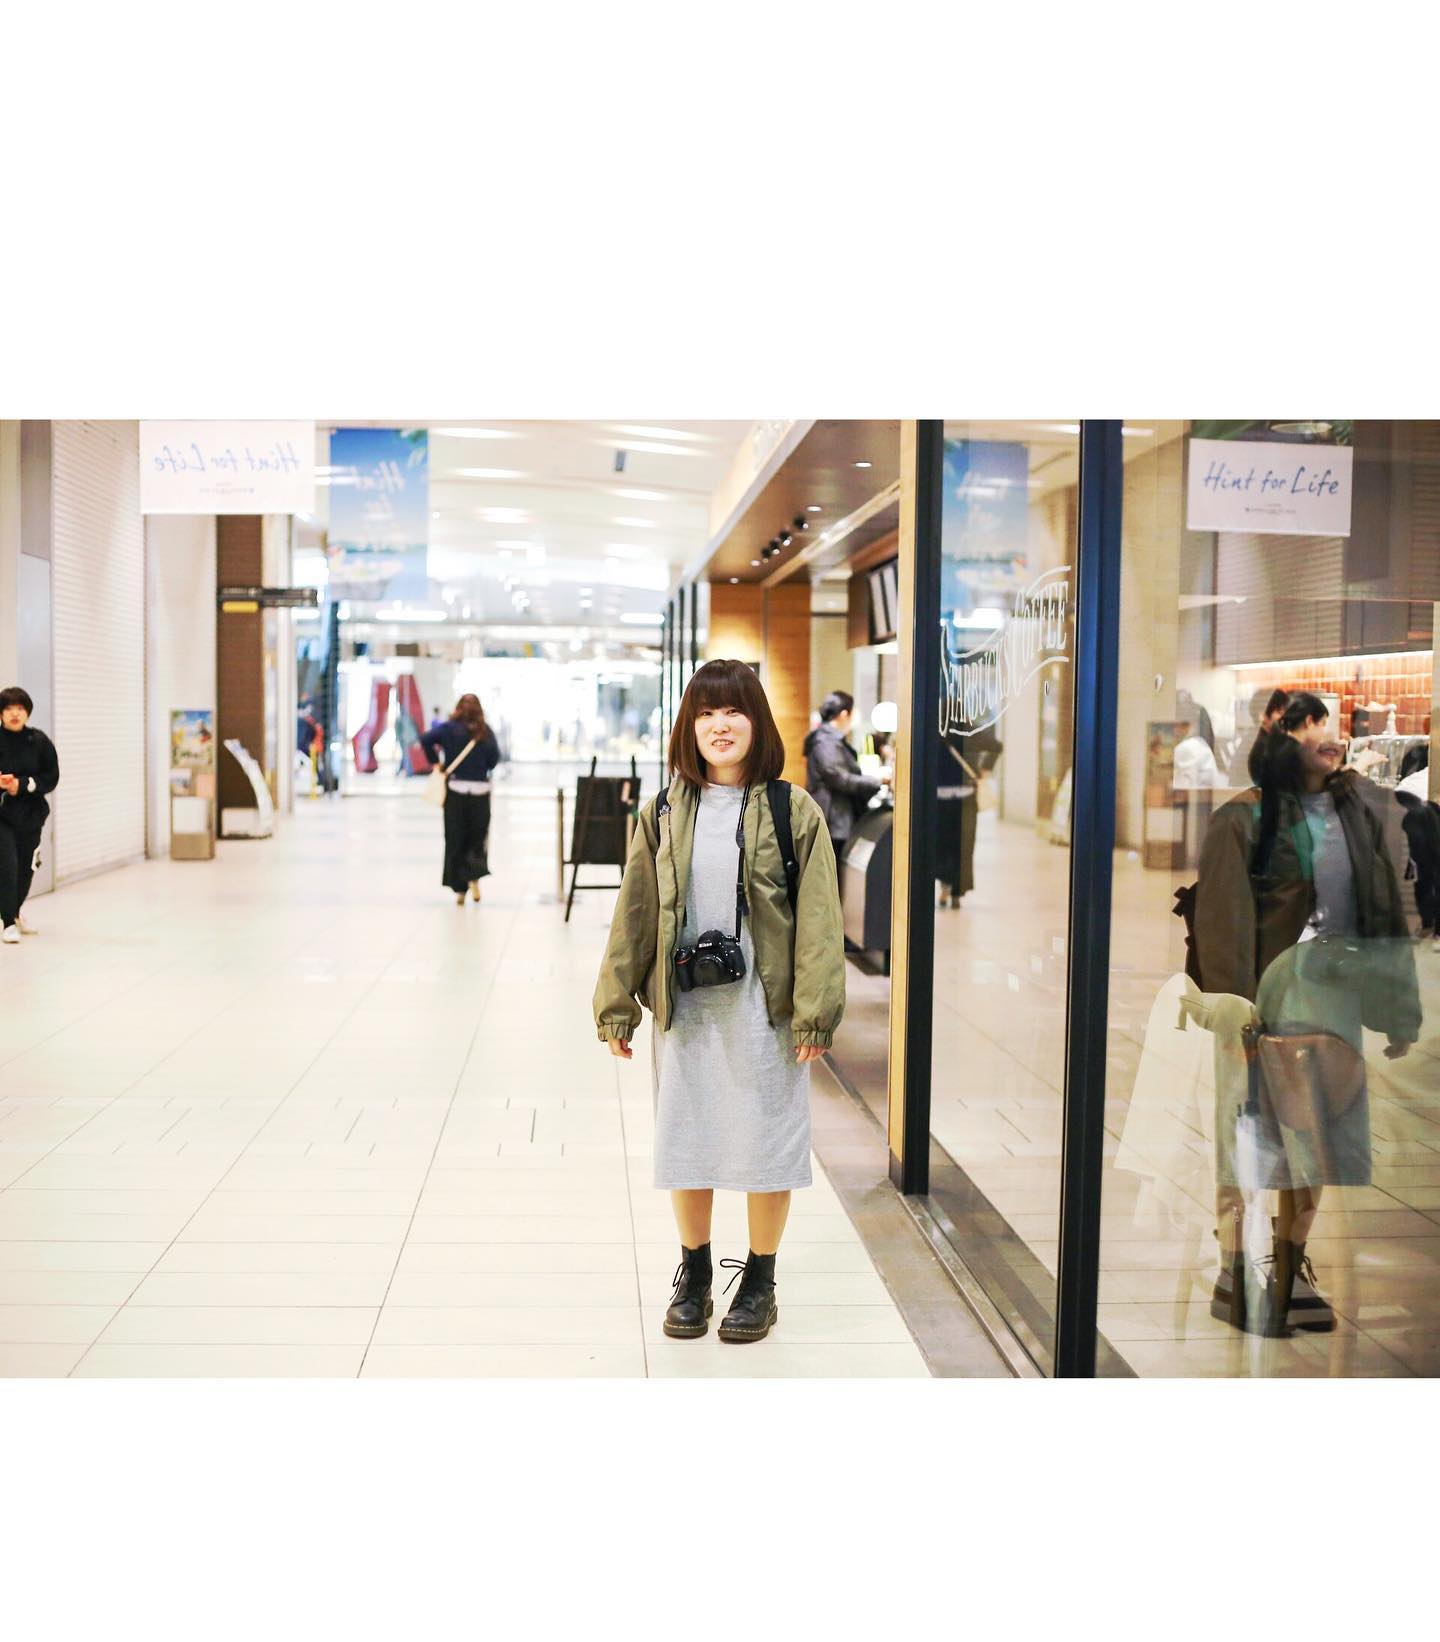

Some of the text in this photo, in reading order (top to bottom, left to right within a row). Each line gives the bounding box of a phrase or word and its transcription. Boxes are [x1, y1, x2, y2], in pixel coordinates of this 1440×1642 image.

[1203, 459, 1340, 497] Hint for Life
[938, 580, 1069, 738] STARBUCKS COFFEE
